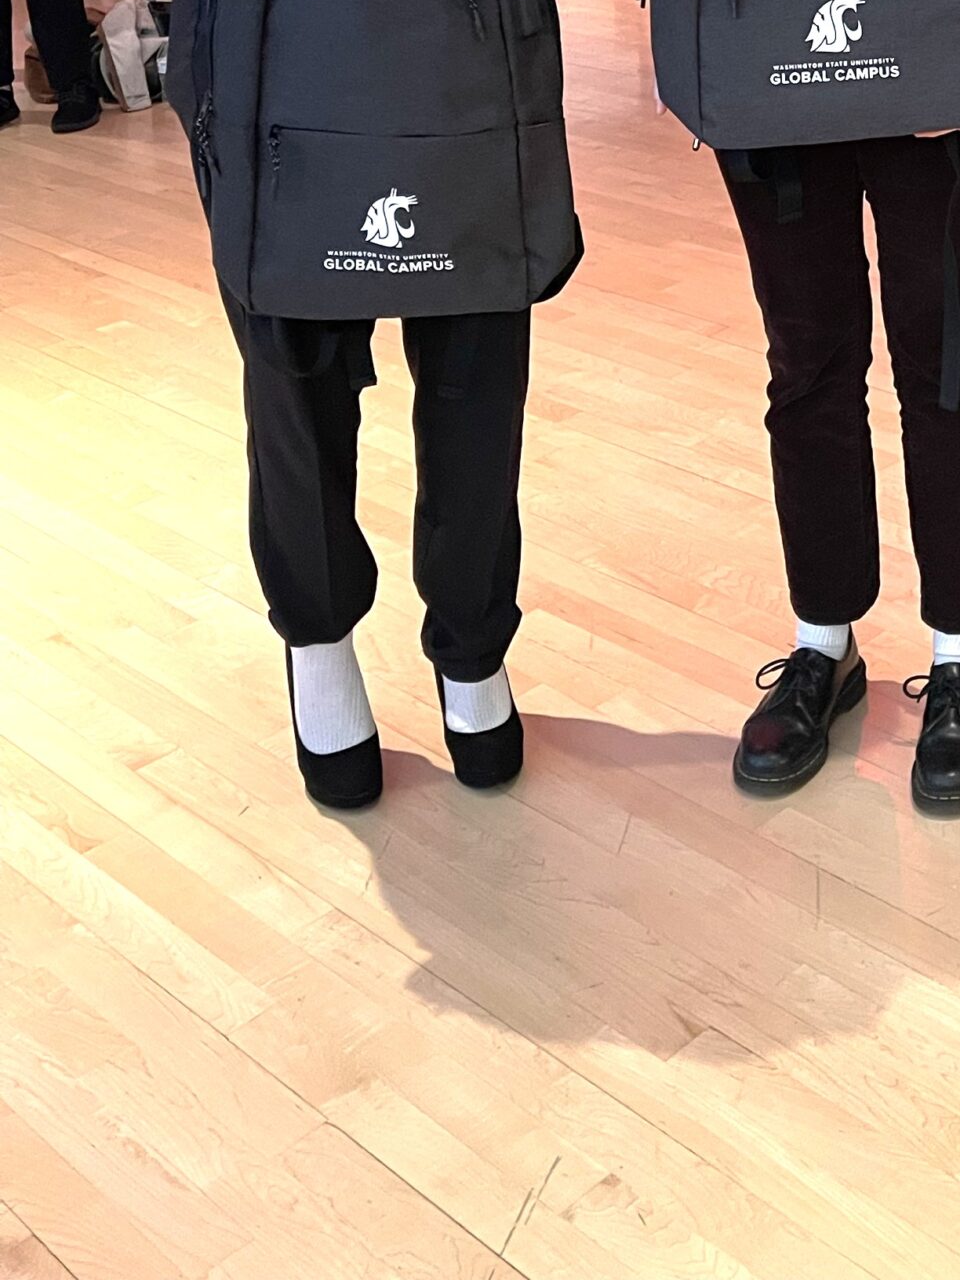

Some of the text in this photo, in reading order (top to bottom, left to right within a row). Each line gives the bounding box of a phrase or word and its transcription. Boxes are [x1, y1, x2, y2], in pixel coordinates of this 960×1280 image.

[773, 57, 895, 71] WASHINGTON STATE UNIVERSITY
[769, 65, 900, 86] GLOBAL CAMPUS
[327, 250, 449, 261] WASHINGTON STATE UNIVERSITY
[323, 258, 455, 273] GLOBAL CAMPUS
